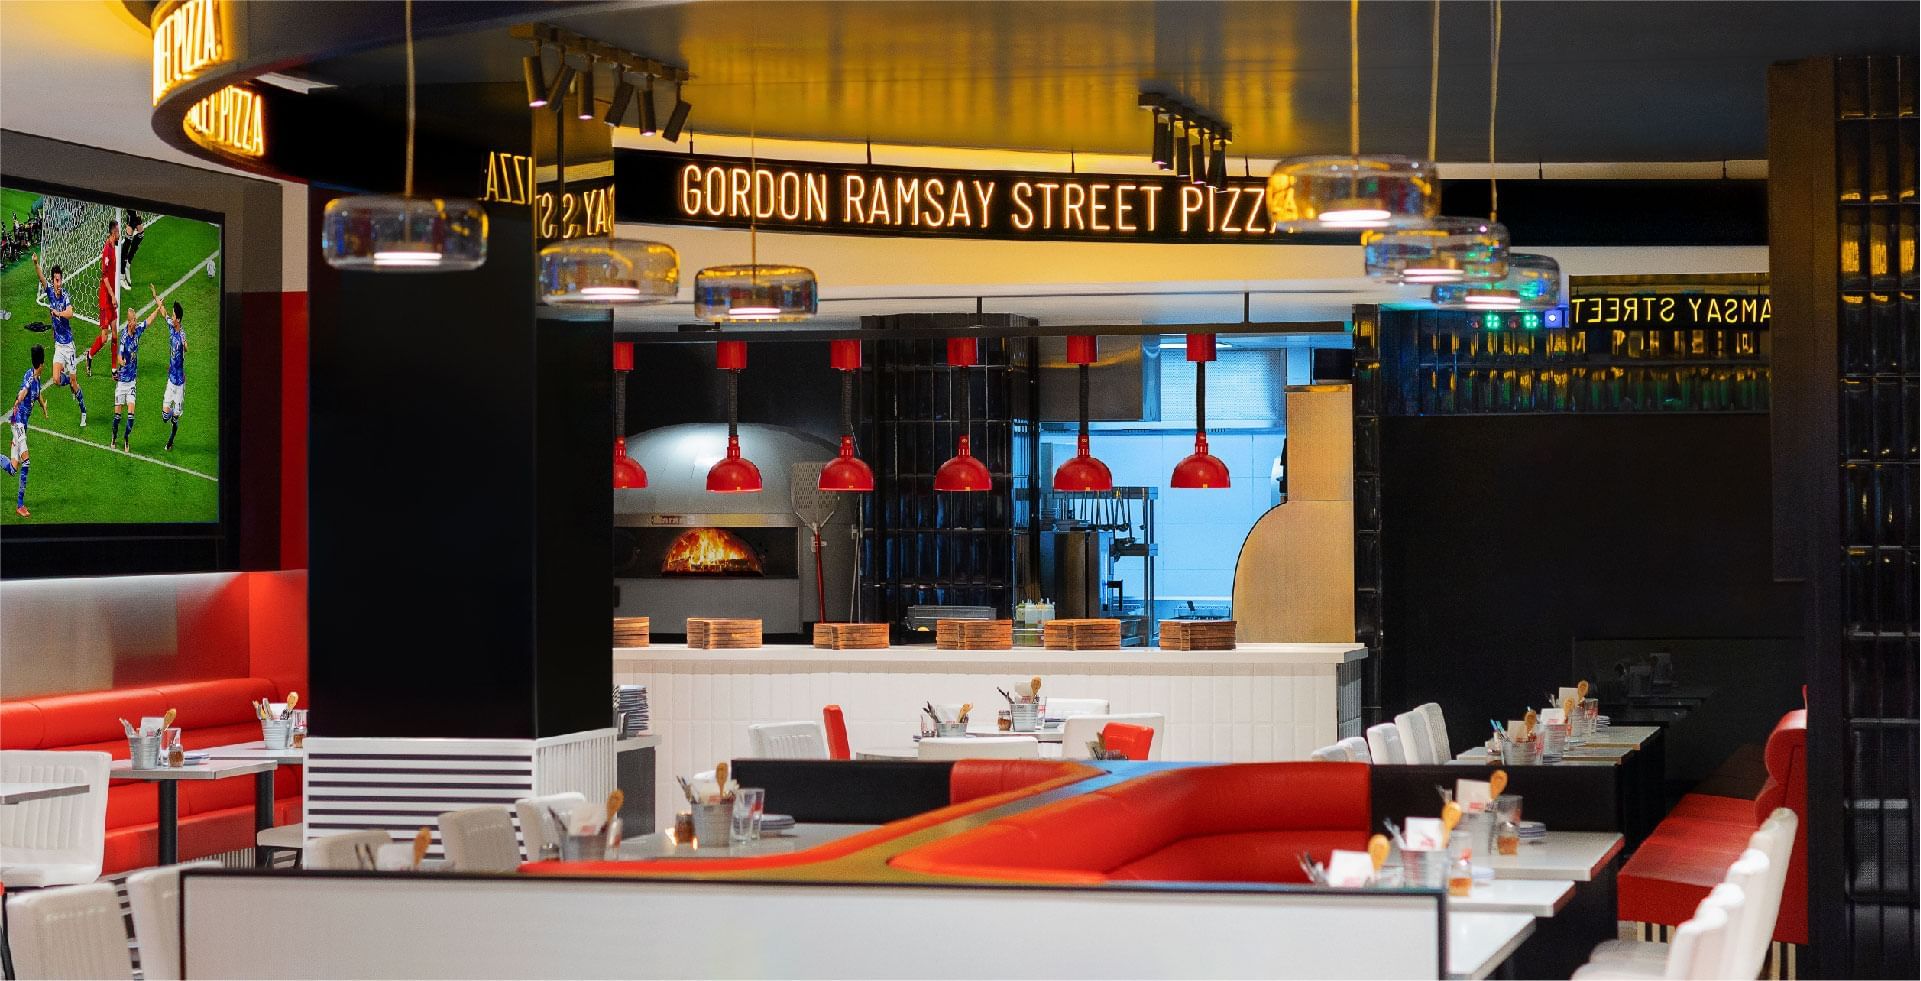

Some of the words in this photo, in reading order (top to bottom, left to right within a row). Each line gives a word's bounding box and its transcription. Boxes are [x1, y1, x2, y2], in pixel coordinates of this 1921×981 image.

[219, 84, 265, 157] PIZZA
[683, 164, 827, 222] GORDON
[843, 174, 995, 228] RAMSAY
[1011, 182, 1163, 232] STREET
[1180, 185, 1293, 234] PIZZ
